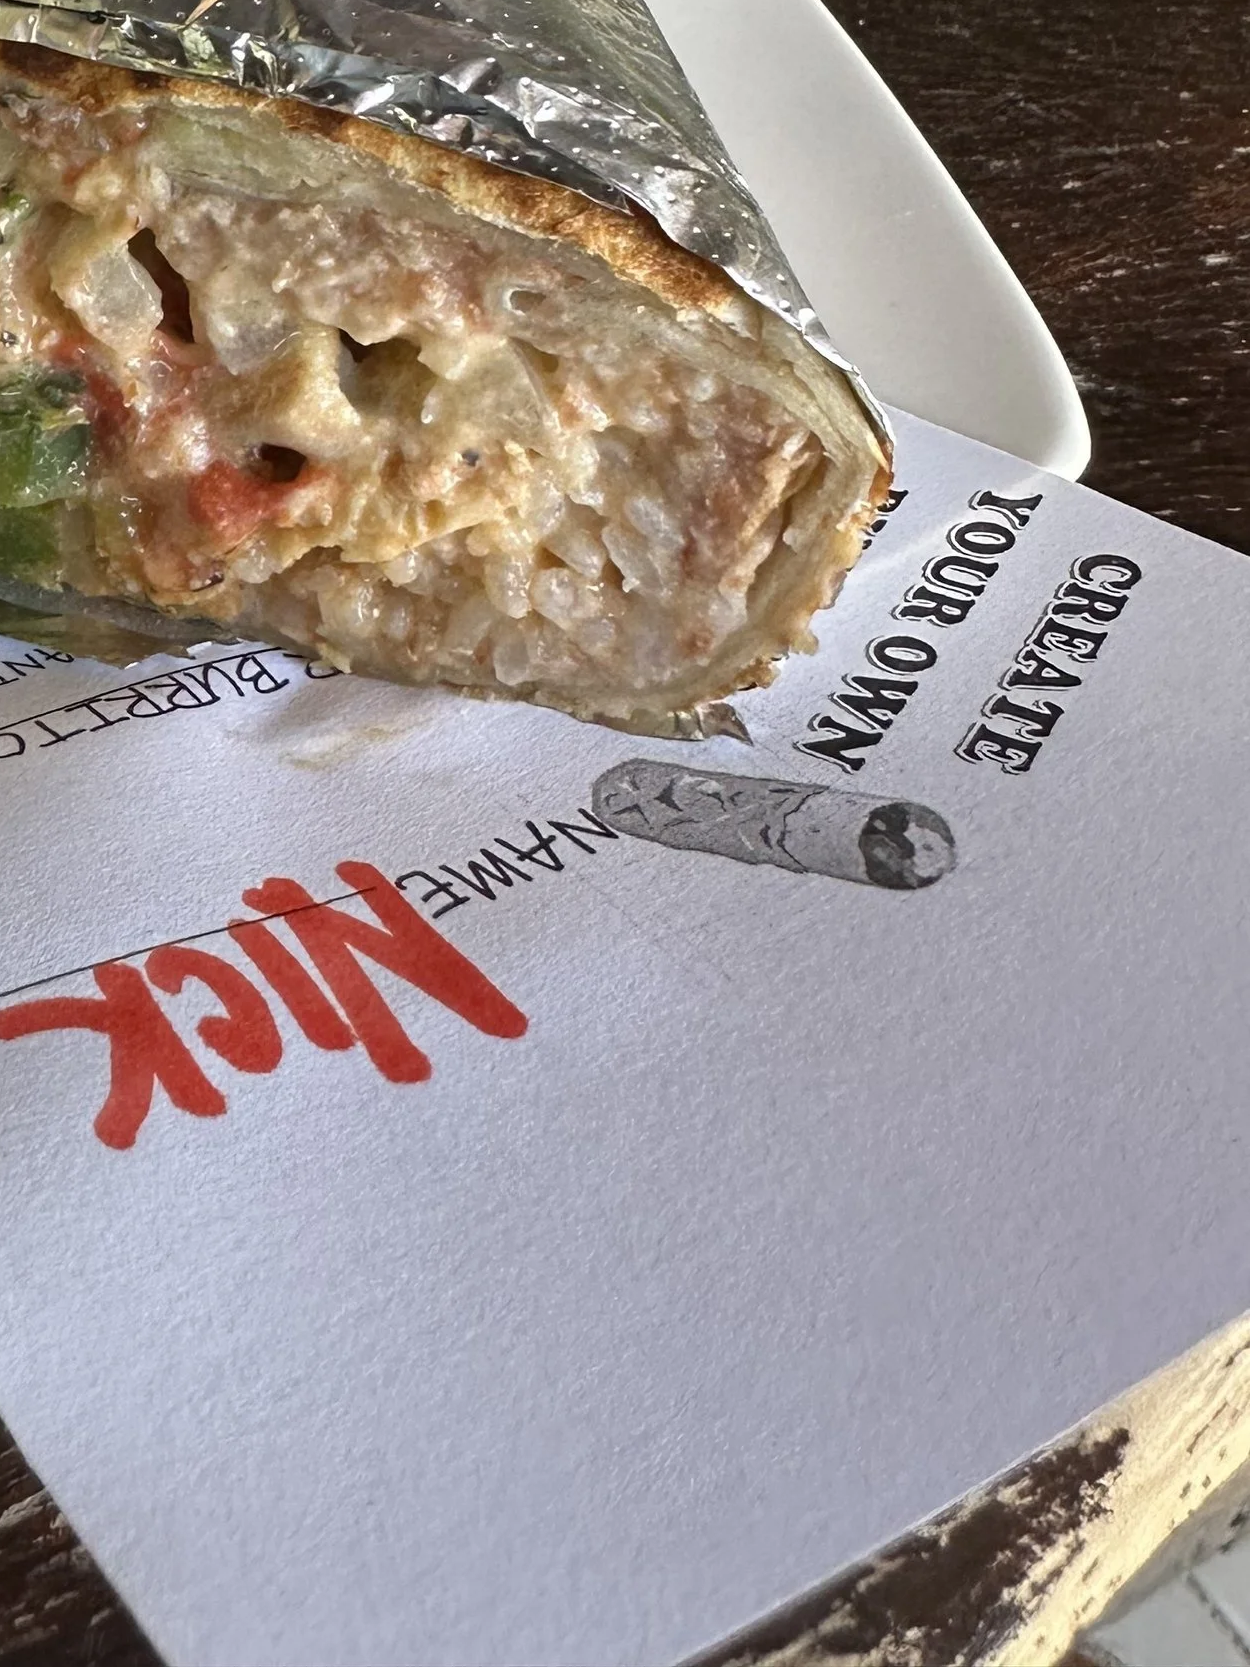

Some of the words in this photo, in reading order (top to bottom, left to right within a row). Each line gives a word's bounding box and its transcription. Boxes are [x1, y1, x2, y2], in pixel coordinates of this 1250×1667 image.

[890, 489, 1044, 628] YOUR
[792, 634, 938, 775] OWN
[953, 553, 1143, 775] CREATE
[394, 807, 620, 920] NAME
